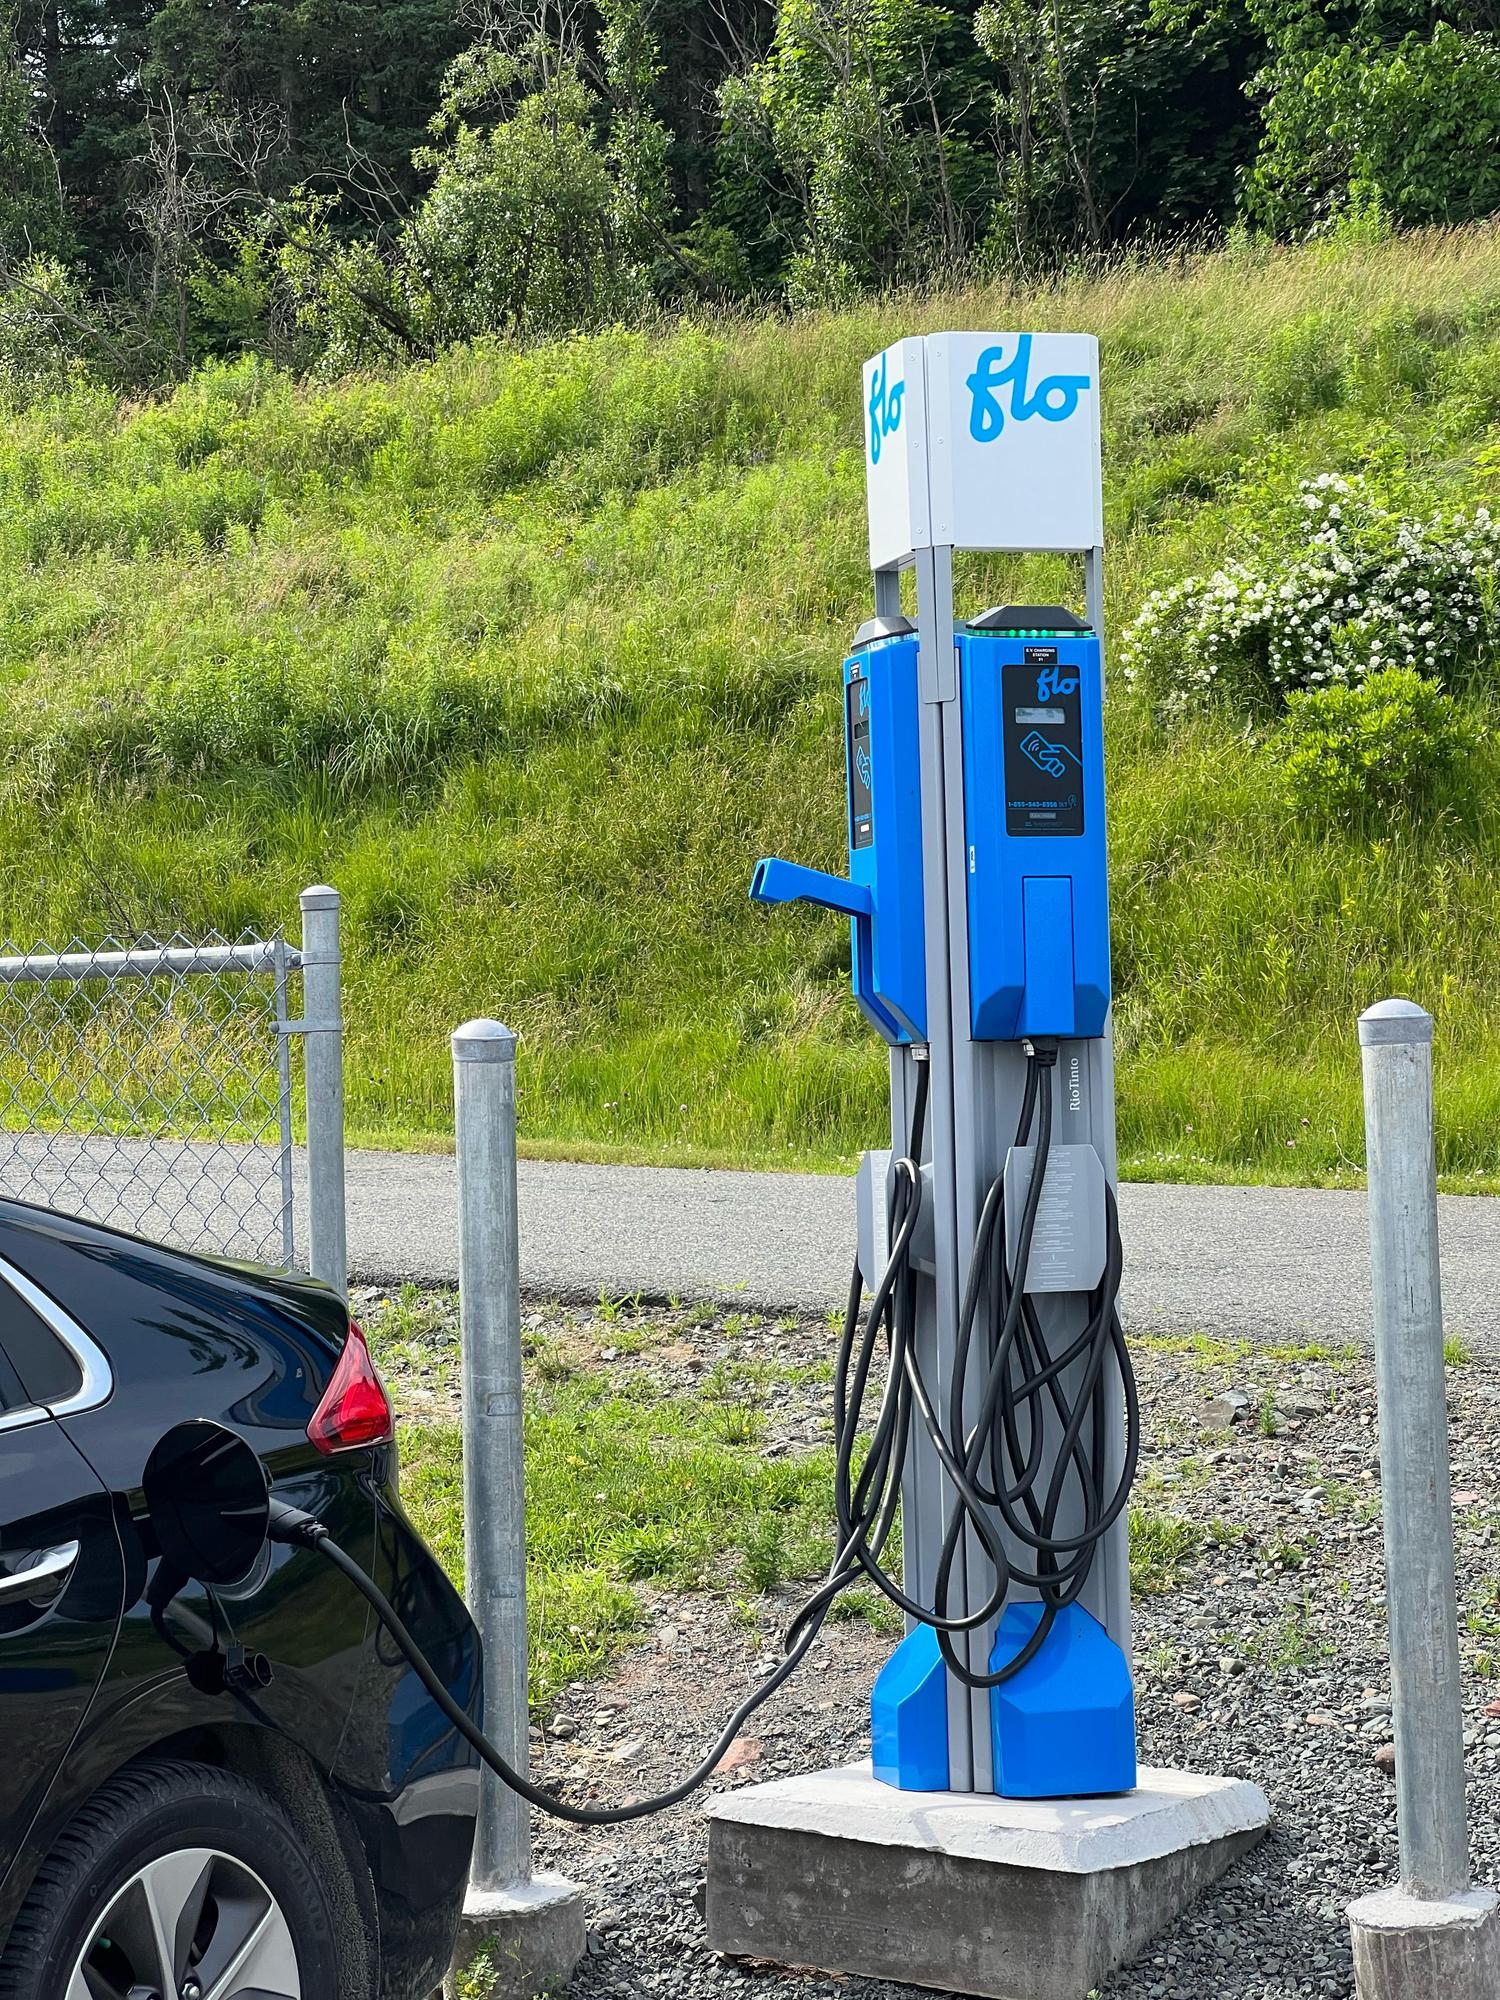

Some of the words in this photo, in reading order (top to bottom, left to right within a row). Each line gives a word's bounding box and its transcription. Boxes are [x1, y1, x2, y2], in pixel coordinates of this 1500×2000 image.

[869, 352, 905, 465] flo
[966, 334, 1090, 442] flo
[1037, 666, 1079, 702] flo
[1069, 1058, 1080, 1110] RioTinto
